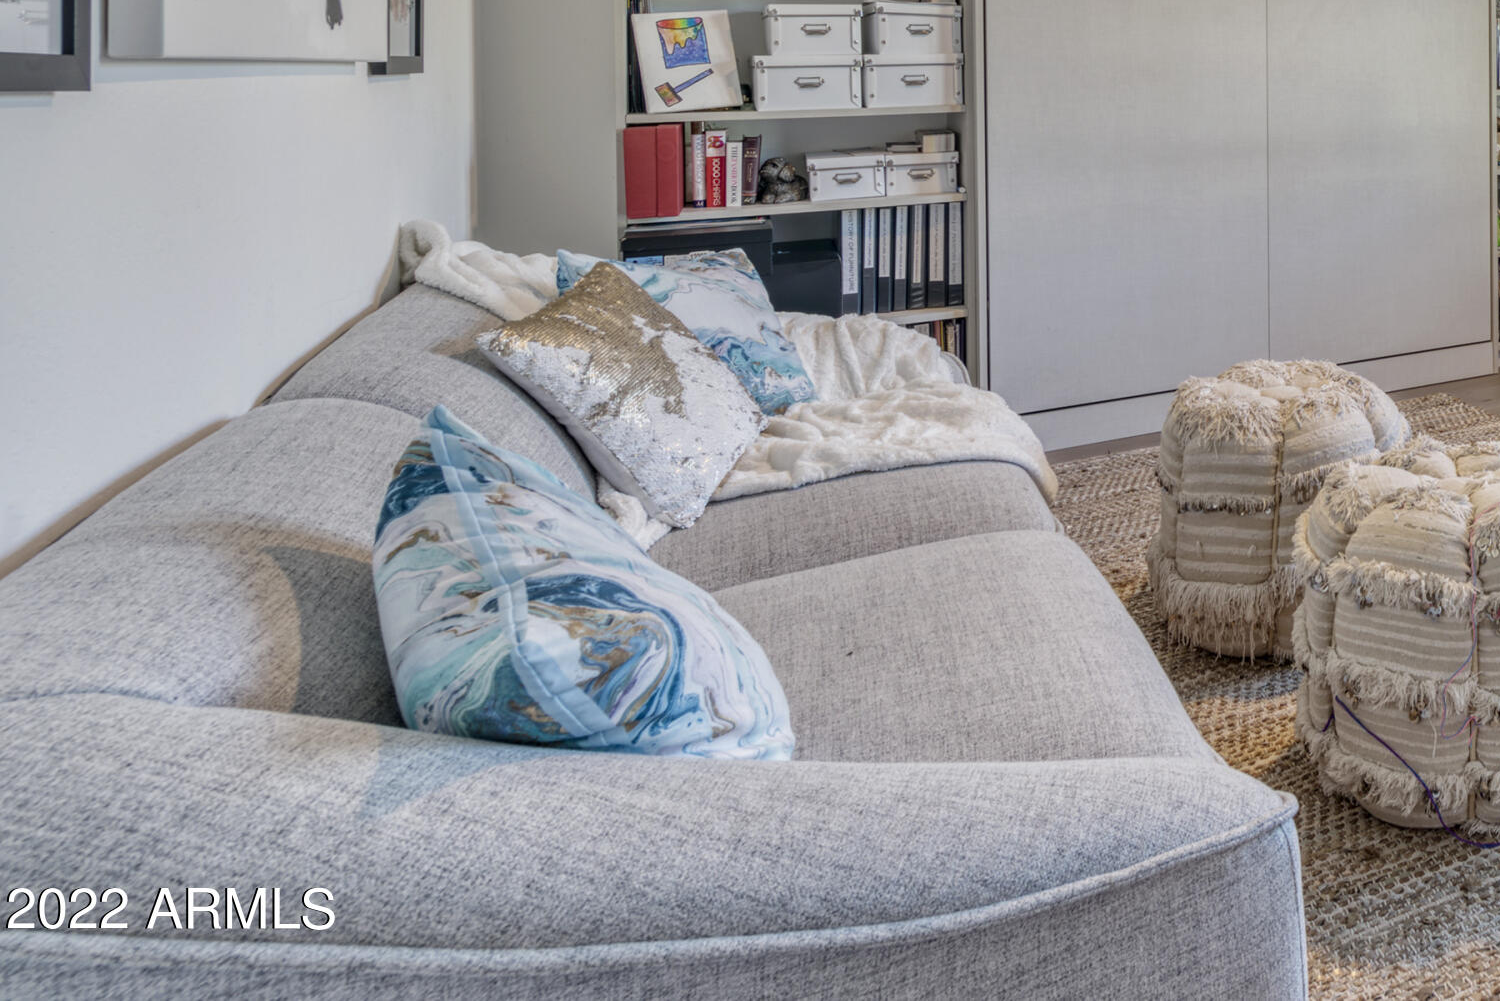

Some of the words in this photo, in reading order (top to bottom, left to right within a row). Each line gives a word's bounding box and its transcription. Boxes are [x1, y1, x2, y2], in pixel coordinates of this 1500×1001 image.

[712, 158, 721, 177] 1000
[712, 179, 721, 206] CHAIRS
[848, 252, 856, 292] FURNITURE
